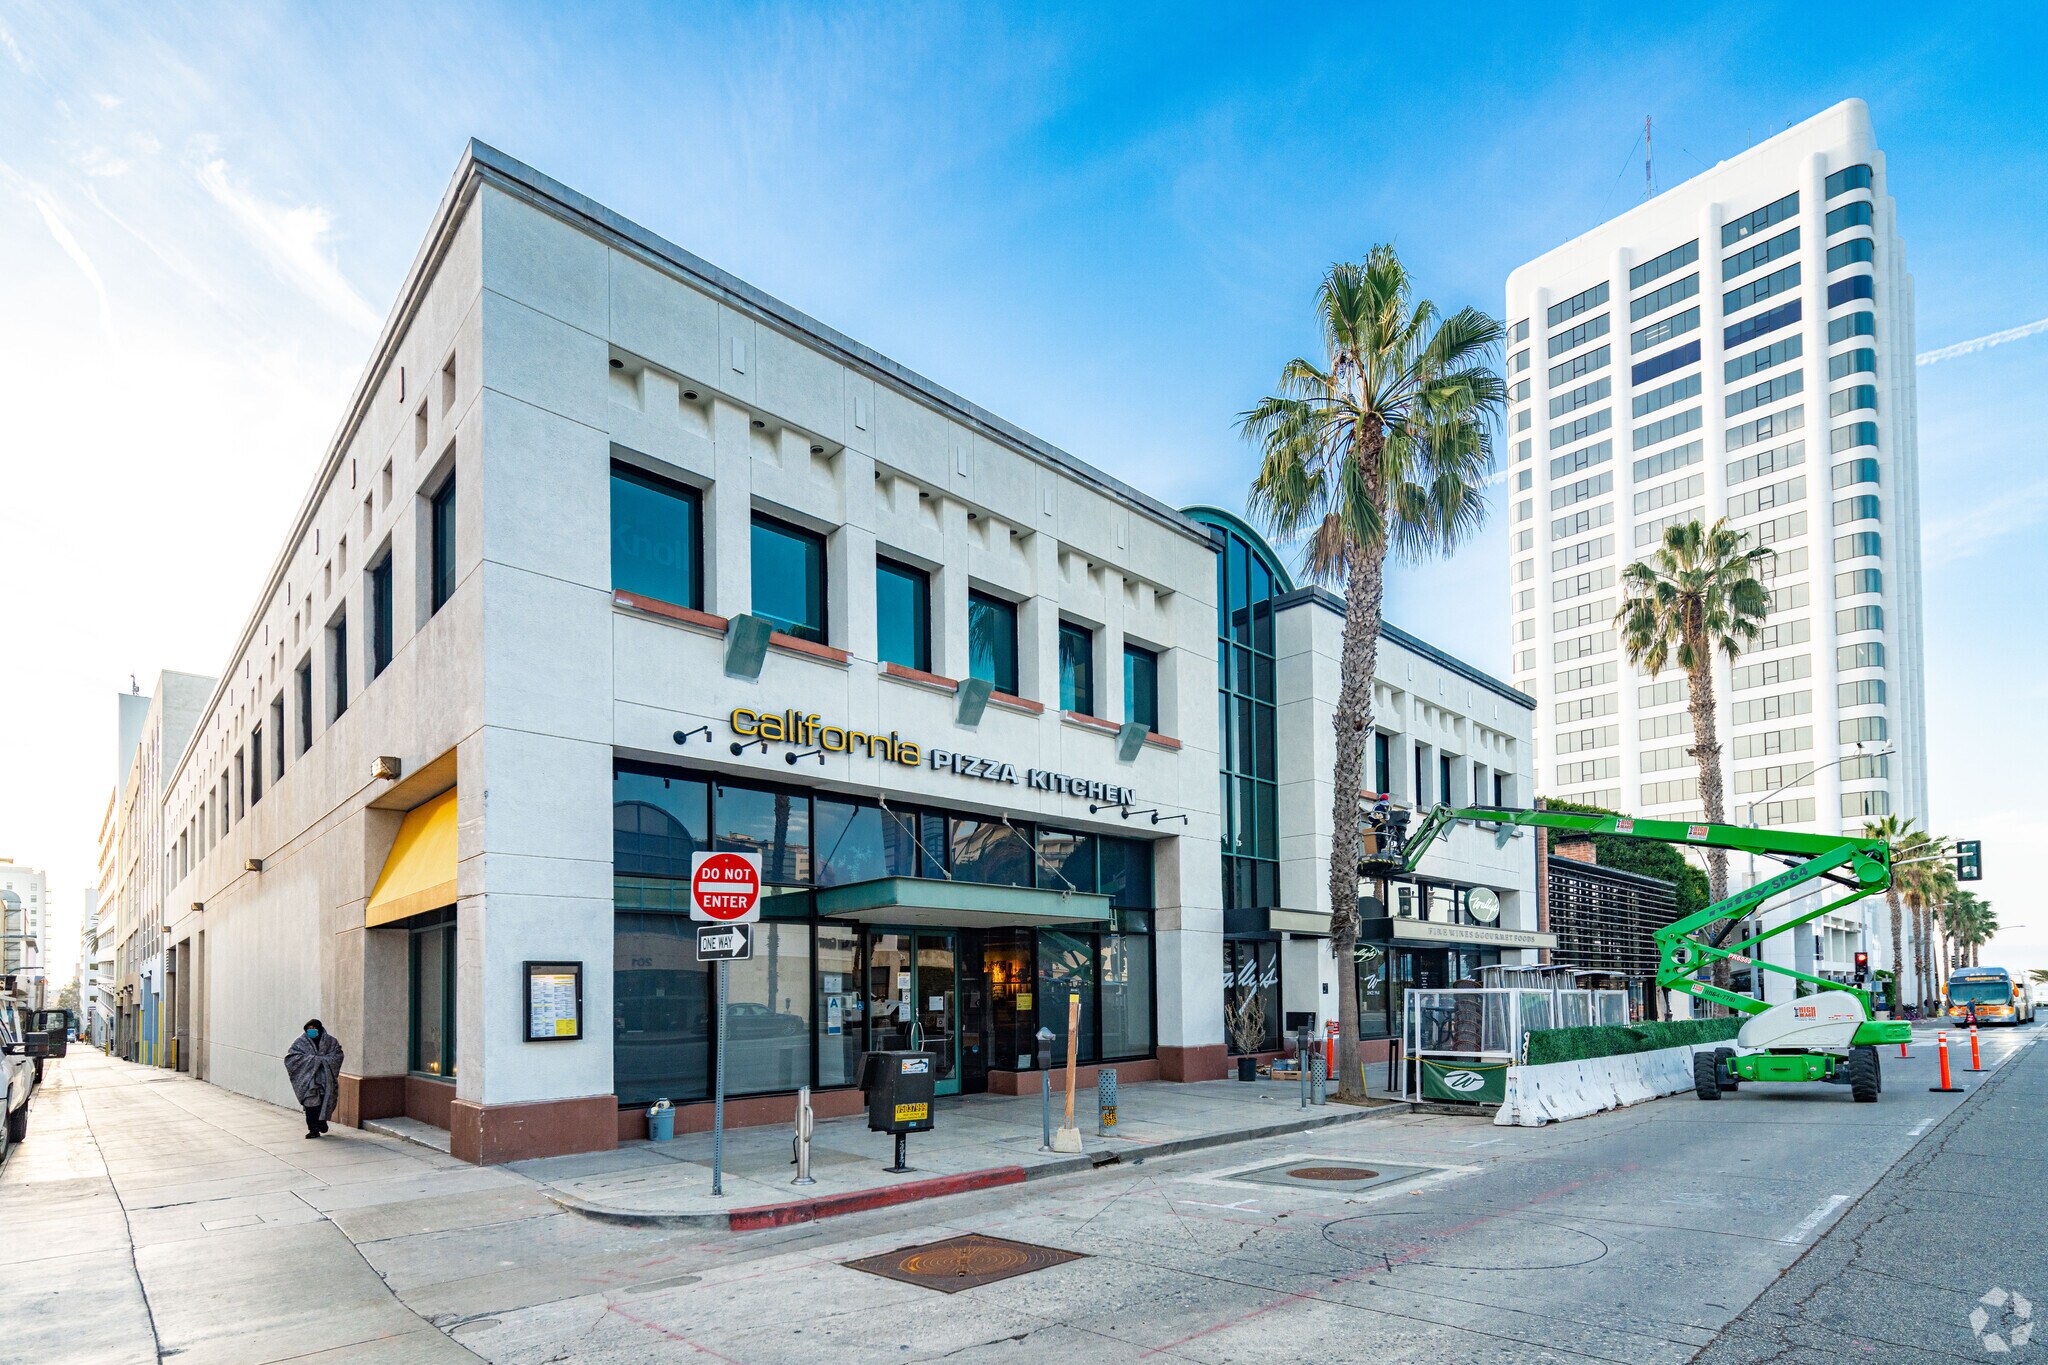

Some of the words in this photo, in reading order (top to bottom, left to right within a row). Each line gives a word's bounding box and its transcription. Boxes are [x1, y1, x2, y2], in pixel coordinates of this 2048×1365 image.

[730, 707, 921, 766] california
[931, 748, 1019, 785] PIZZA
[1027, 768, 1136, 806] KITCHEN
[702, 868, 720, 880] DO
[725, 868, 751, 880] NOT
[1709, 884, 1770, 917] nifty
[1771, 867, 1808, 889] SP64
[703, 895, 747, 908] ENTER
[1428, 927, 1448, 936] FINE
[1449, 929, 1473, 938] WINES
[1514, 935, 1535, 943] FOODS
[702, 937, 717, 950] ONE
[719, 936, 733, 949] WAY
[830, 998, 838, 1008] A
